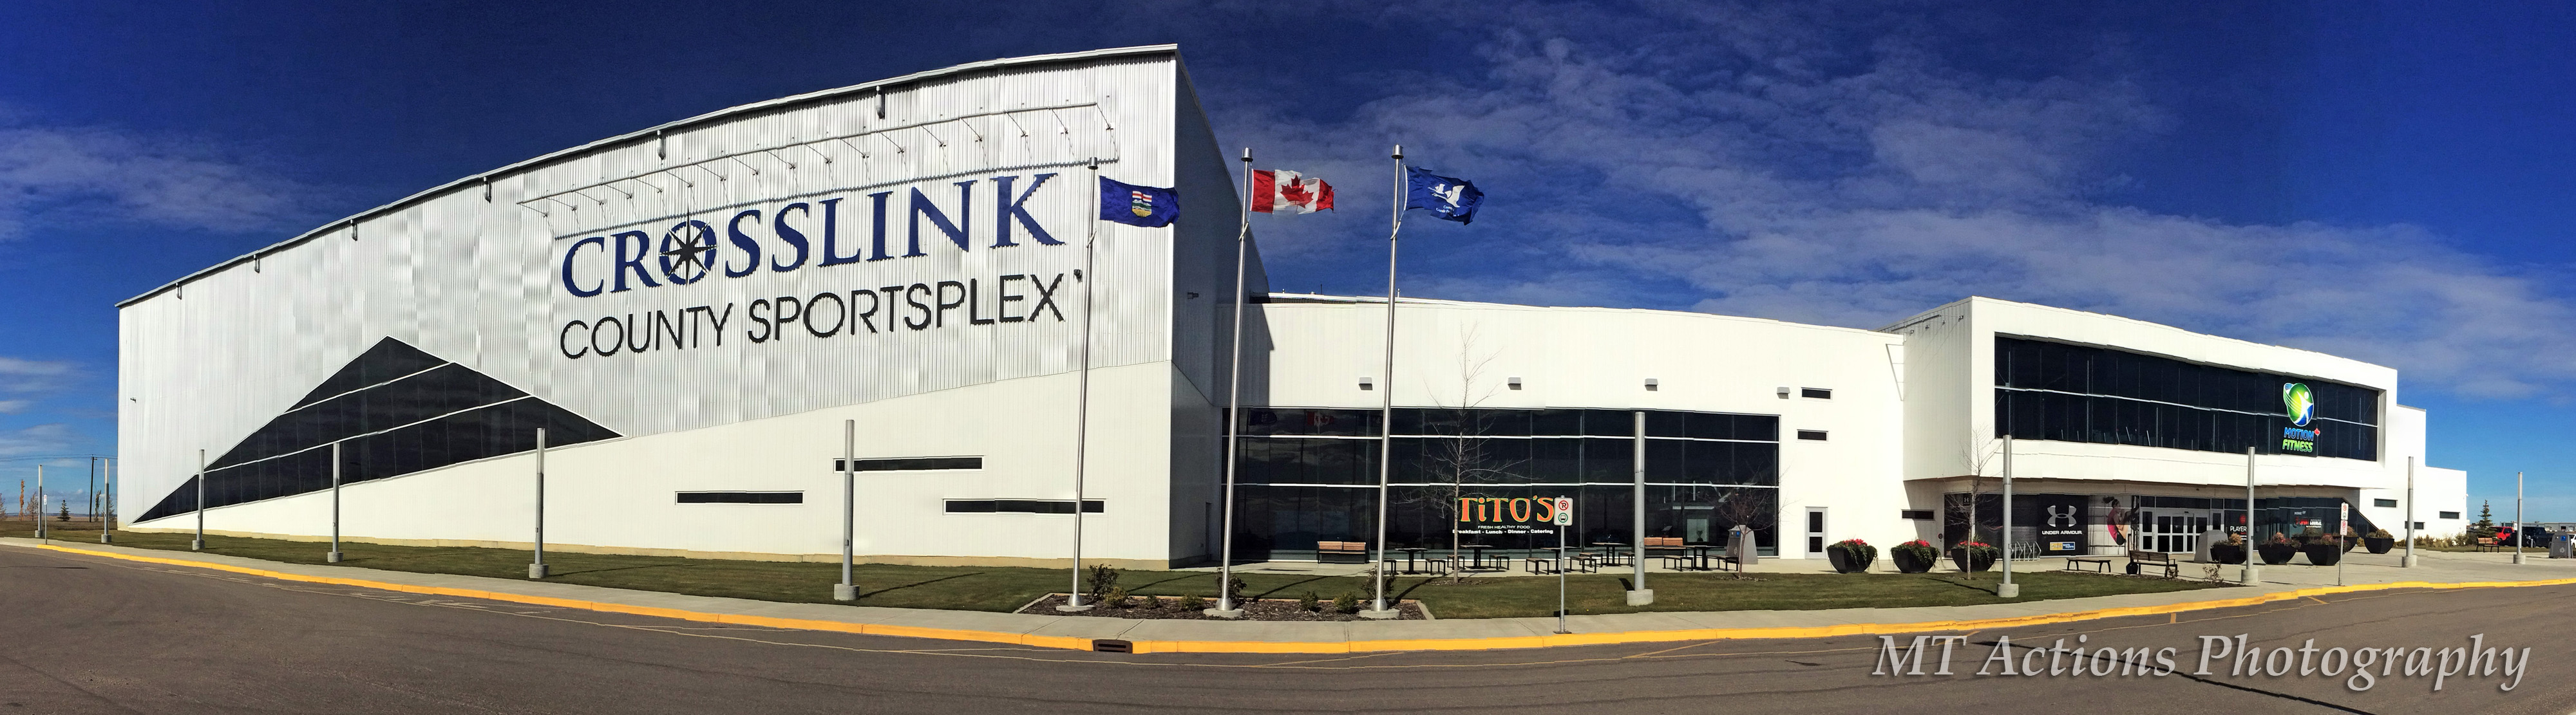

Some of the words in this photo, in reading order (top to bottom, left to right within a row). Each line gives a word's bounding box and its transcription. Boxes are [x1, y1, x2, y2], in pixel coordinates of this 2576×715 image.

[562, 172, 1066, 298] CROSSLINK
[560, 302, 733, 359] COUNTY
[748, 273, 1065, 344] SPORTSPLEX
[2282, 438, 2313, 452] FITNESS
[2284, 427, 2315, 441] MOTION
